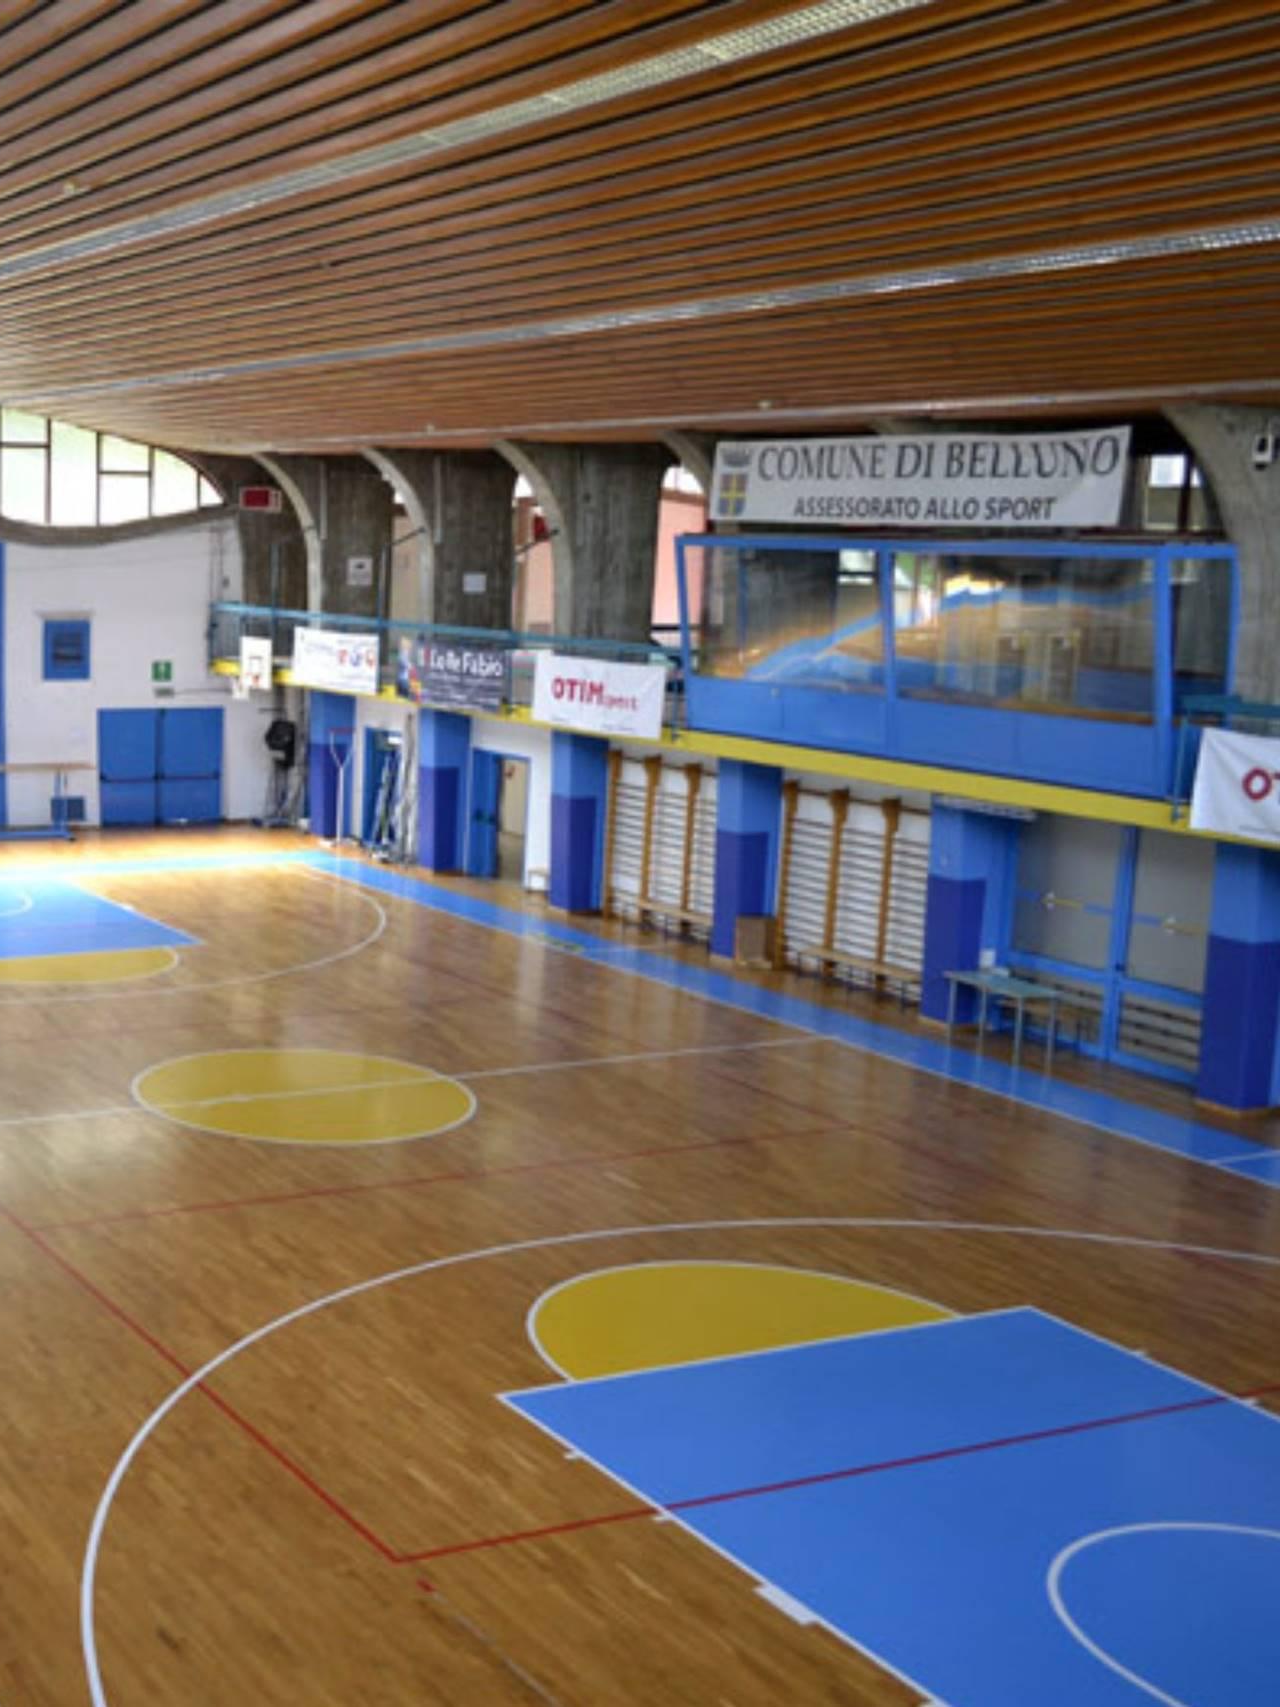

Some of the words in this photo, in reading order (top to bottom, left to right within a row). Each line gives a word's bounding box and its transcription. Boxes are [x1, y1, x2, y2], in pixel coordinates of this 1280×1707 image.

[757, 444, 887, 482] COMUNE
[893, 442, 935, 479] DI
[944, 434, 1120, 479] BELLUNO
[793, 496, 920, 520] ASSESSORATO
[923, 497, 980, 520] ALLO
[984, 497, 1057, 521] SPORT
[1241, 766, 1280, 801] O
